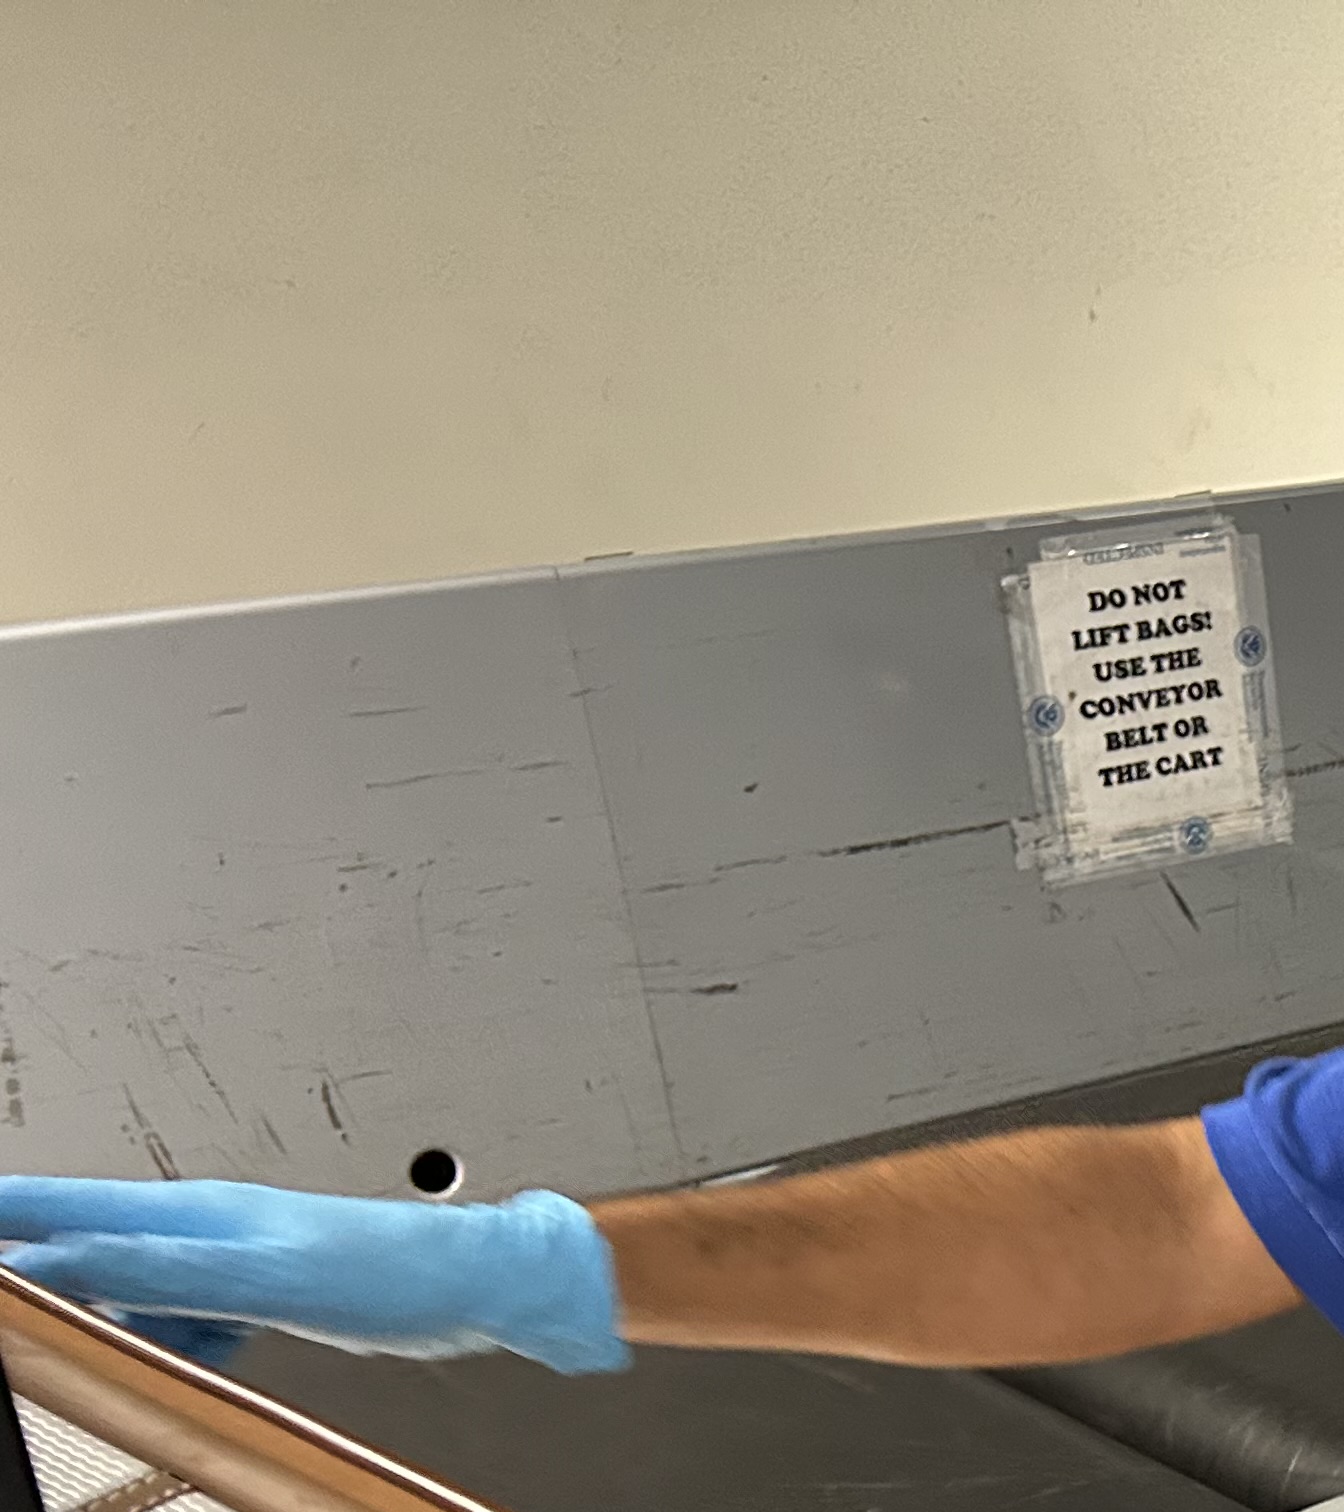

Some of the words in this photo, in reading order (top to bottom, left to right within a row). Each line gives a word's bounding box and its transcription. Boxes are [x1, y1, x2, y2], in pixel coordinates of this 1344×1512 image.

[1087, 588, 1126, 612] DO
[1133, 579, 1187, 606] NOT
[1071, 624, 1130, 651] LIFT
[1136, 611, 1213, 642] BAGS!
[1092, 655, 1147, 682] USE
[1149, 647, 1203, 674] THE
[1079, 679, 1224, 719] CONVEYOR
[1103, 723, 1172, 752] BELT
[1173, 715, 1209, 738] OR
[1098, 763, 1151, 787] THE
[1155, 747, 1224, 777] CART
